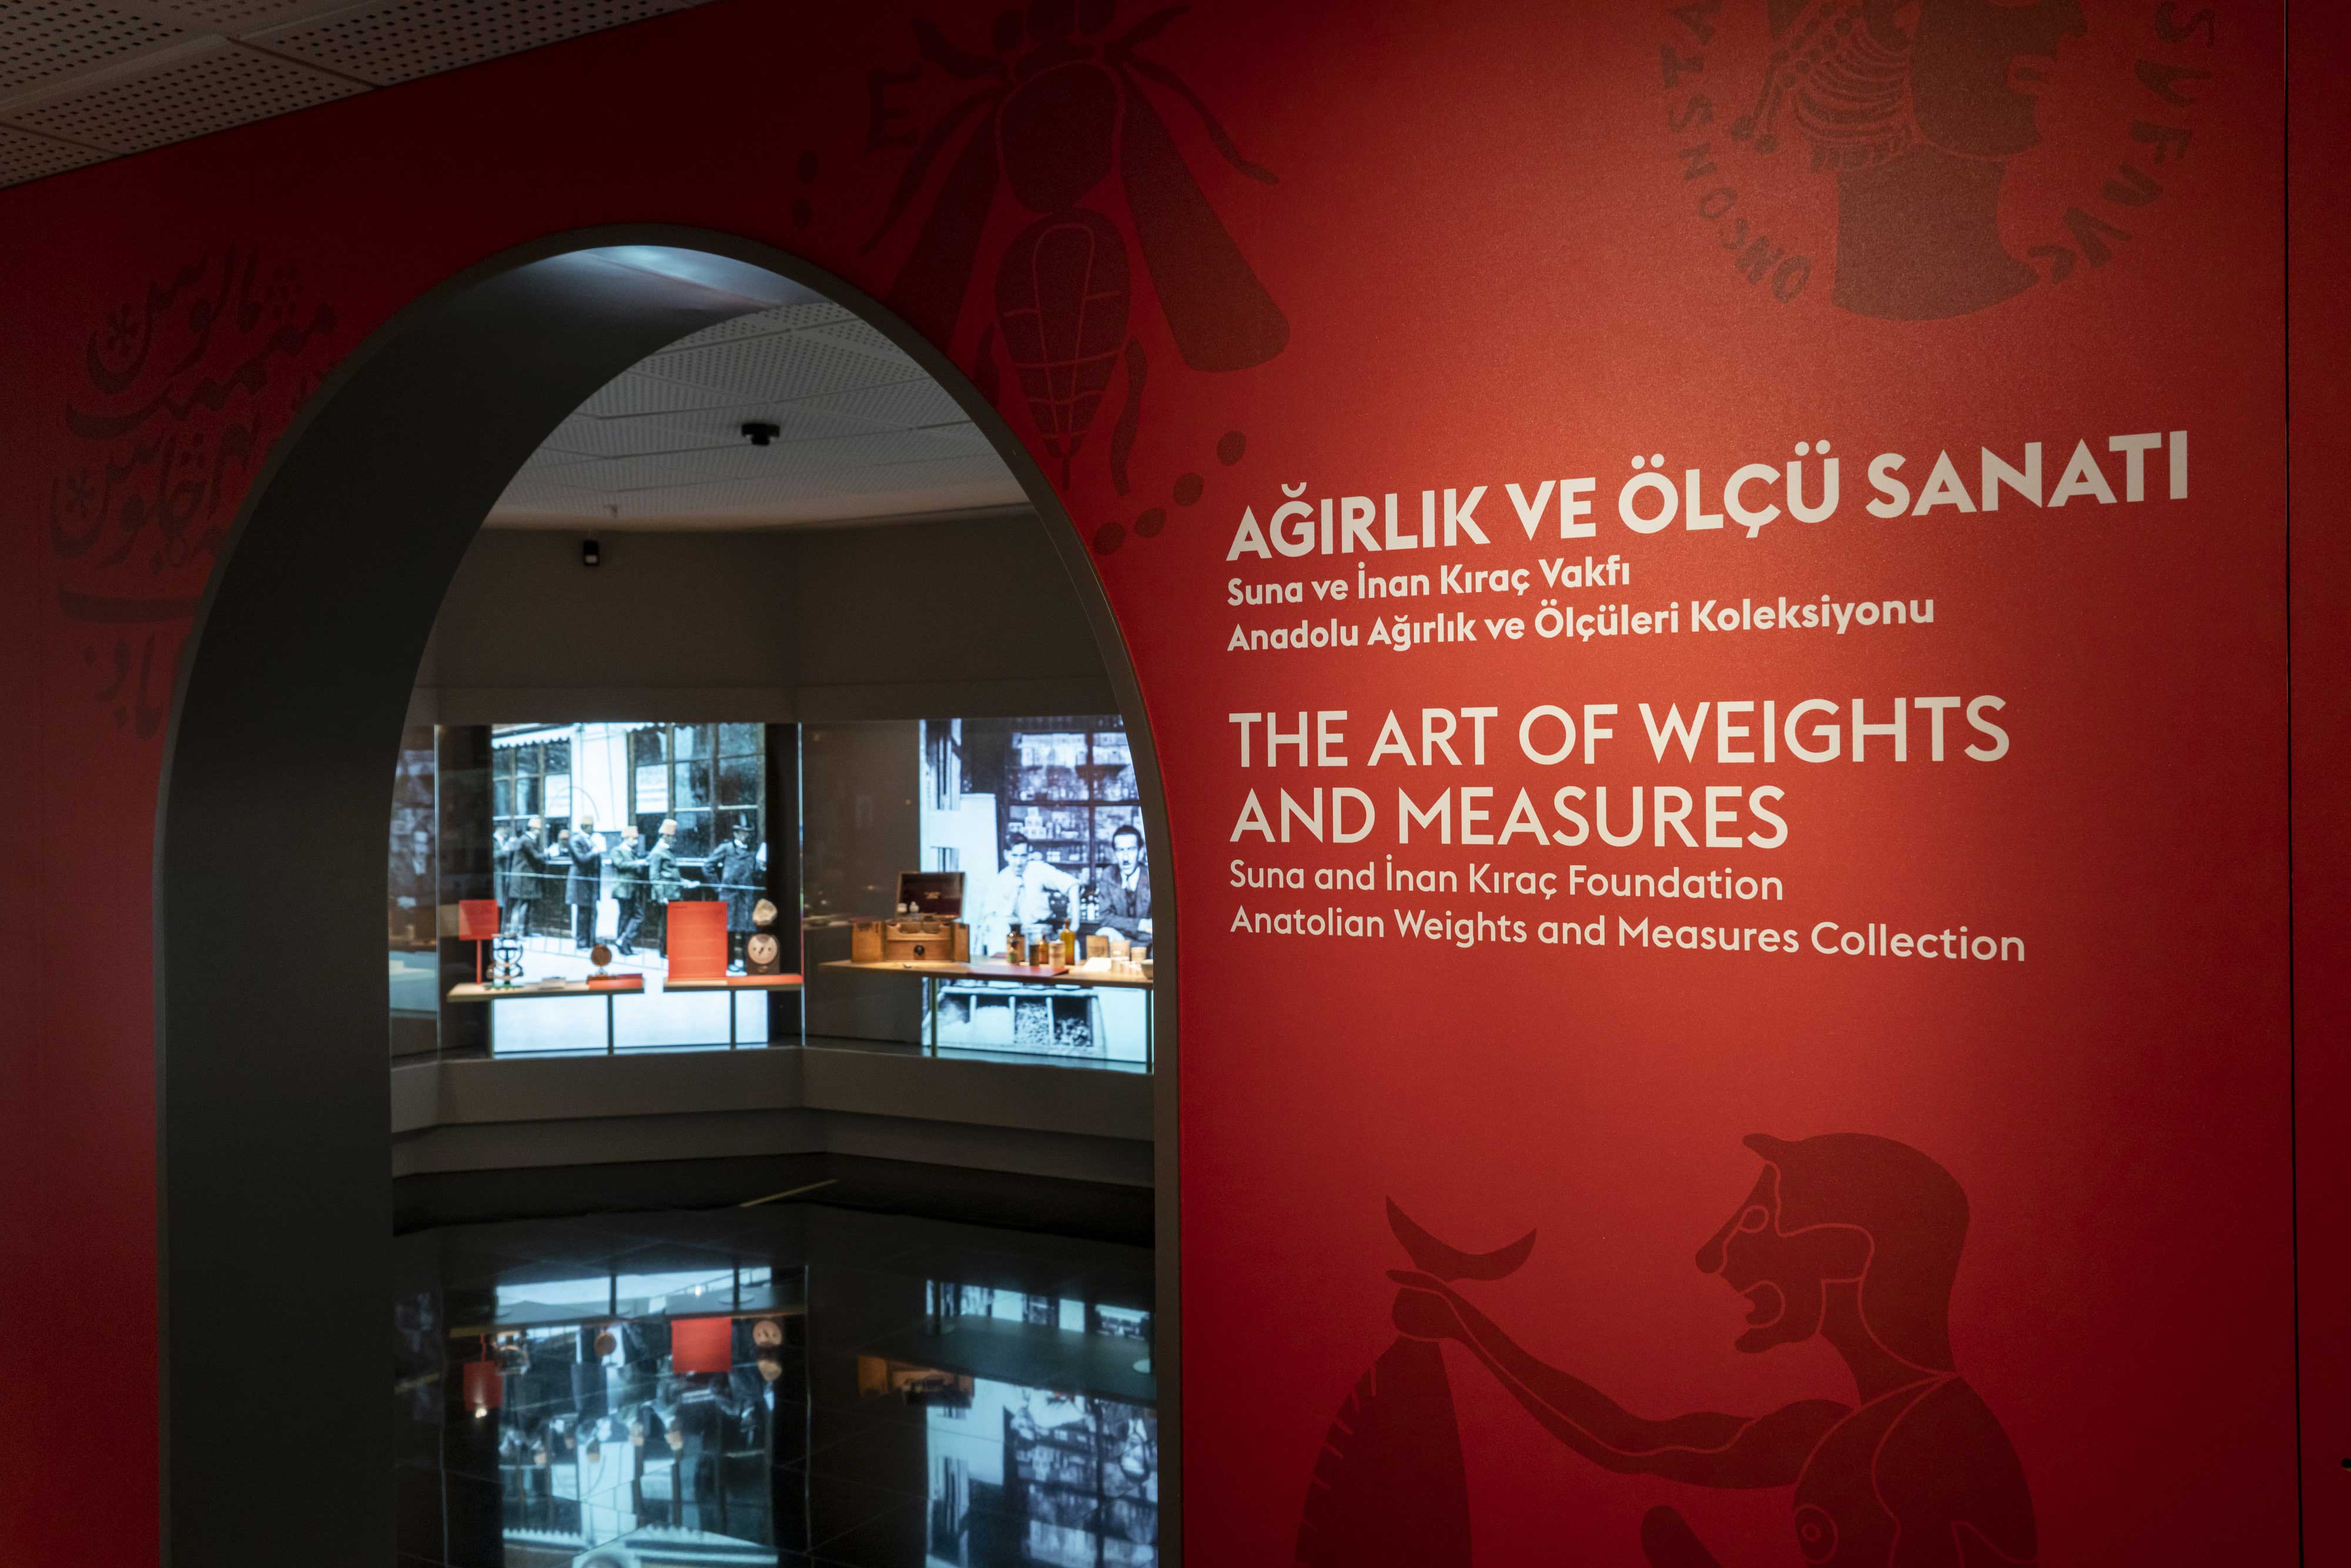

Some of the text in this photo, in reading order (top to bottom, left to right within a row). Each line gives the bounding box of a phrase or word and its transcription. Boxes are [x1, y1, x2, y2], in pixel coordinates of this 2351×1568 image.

[1227, 431, 2187, 561] AĞIRLIK VE ÖLÇÜ SANATI
[1228, 555, 1630, 605] Suna ve İnan Kıraç Vakfı
[1227, 595, 1933, 651] Anadolu Ağırlık ve Ölçüleri Koleksiyonu
[1229, 695, 2009, 767] THE ART OF WEIGHTS
[1230, 785, 1788, 849] AND MEASURES
[1230, 854, 1783, 900] Suna and İnan Kıraç Foundation
[1231, 906, 2024, 961] Anatolian Weights and Measures Collection
